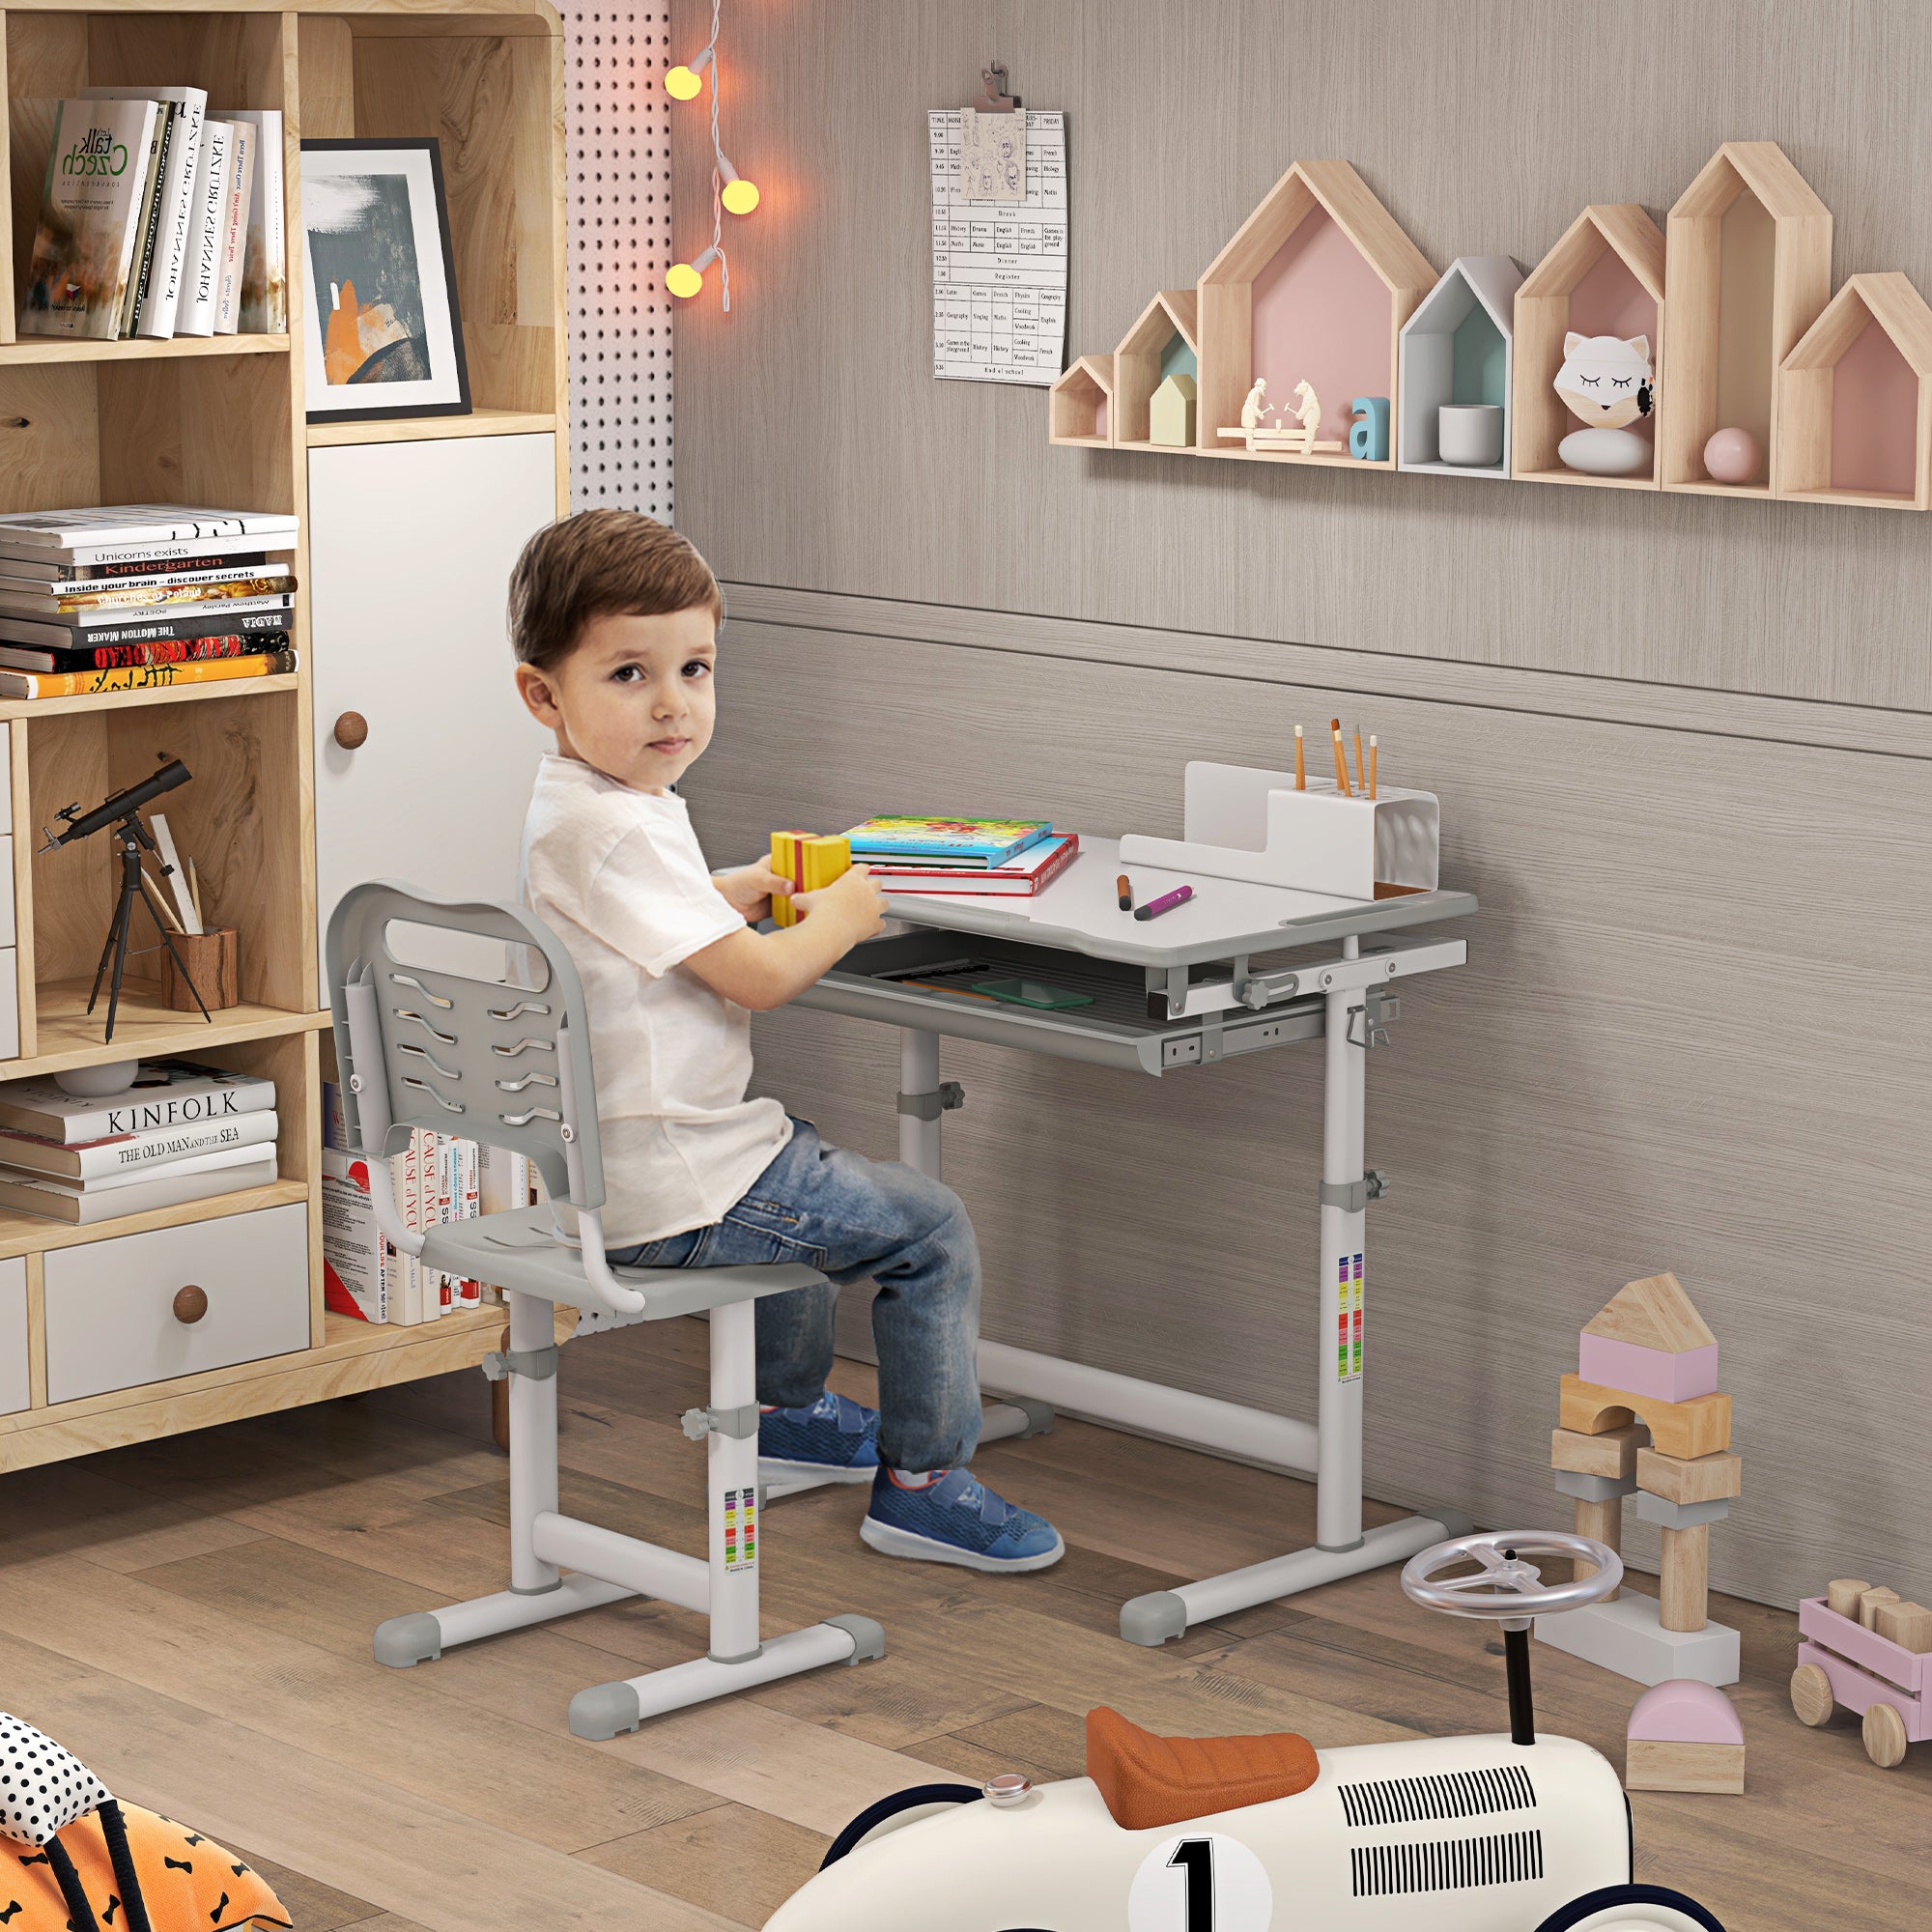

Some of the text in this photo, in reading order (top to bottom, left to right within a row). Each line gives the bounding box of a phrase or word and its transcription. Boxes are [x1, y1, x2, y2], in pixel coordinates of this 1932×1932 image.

[95, 547, 189, 562] Unicorns exists
[105, 556, 223, 575] Kindergarten
[65, 583, 99, 593] Inside
[101, 582, 128, 591] your
[128, 579, 156, 587] brain
[167, 576, 214, 585] discover
[215, 570, 255, 581] secrets
[97, 587, 201, 605] Churches of Poland
[232, 599, 270, 608] Matthew
[242, 614, 283, 628] NADIA
[87, 626, 176, 642] THE MOTION MAKER
[109, 1092, 239, 1134] KINFOLK
[118, 1150, 141, 1164] THE
[143, 1142, 165, 1159] OLD
[167, 1136, 190, 1152] MAN
[205, 1135, 218, 1145] THE
[220, 1126, 240, 1143] SEA
[406, 1188, 417, 1198] of
[425, 1184, 435, 1194] of
[1166, 1837, 1215, 1932] 1
